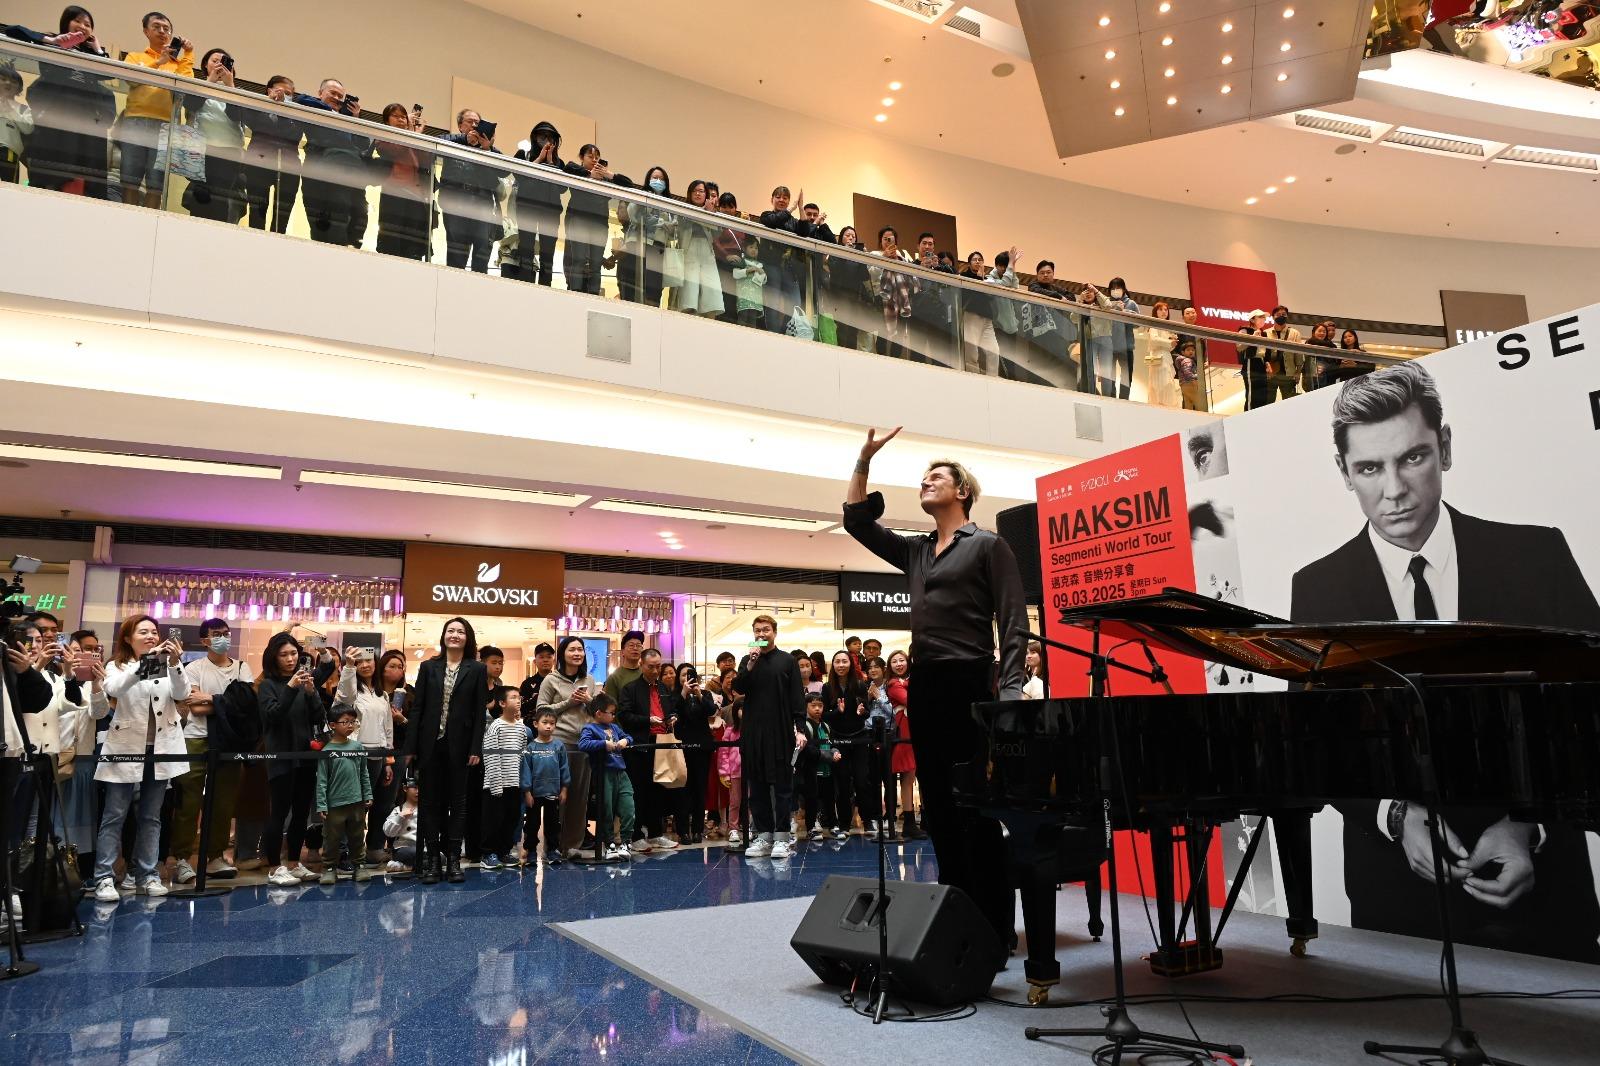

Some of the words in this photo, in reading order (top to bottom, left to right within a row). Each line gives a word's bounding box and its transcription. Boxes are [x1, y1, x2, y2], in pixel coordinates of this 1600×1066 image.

[1048, 486, 1171, 545] MAKSIM
[1051, 543, 1102, 565] Segmenti
[1105, 535, 1140, 554] World
[1143, 531, 1173, 546] Tour
[1084, 563, 1135, 584] 音樂分享會
[1130, 578, 1151, 589] 星期日
[1152, 576, 1167, 585] Sun
[432, 584, 539, 606] SWAROVSKI
[1053, 582, 1126, 609] 09.03.2025
[1131, 588, 1146, 597] 3pm
